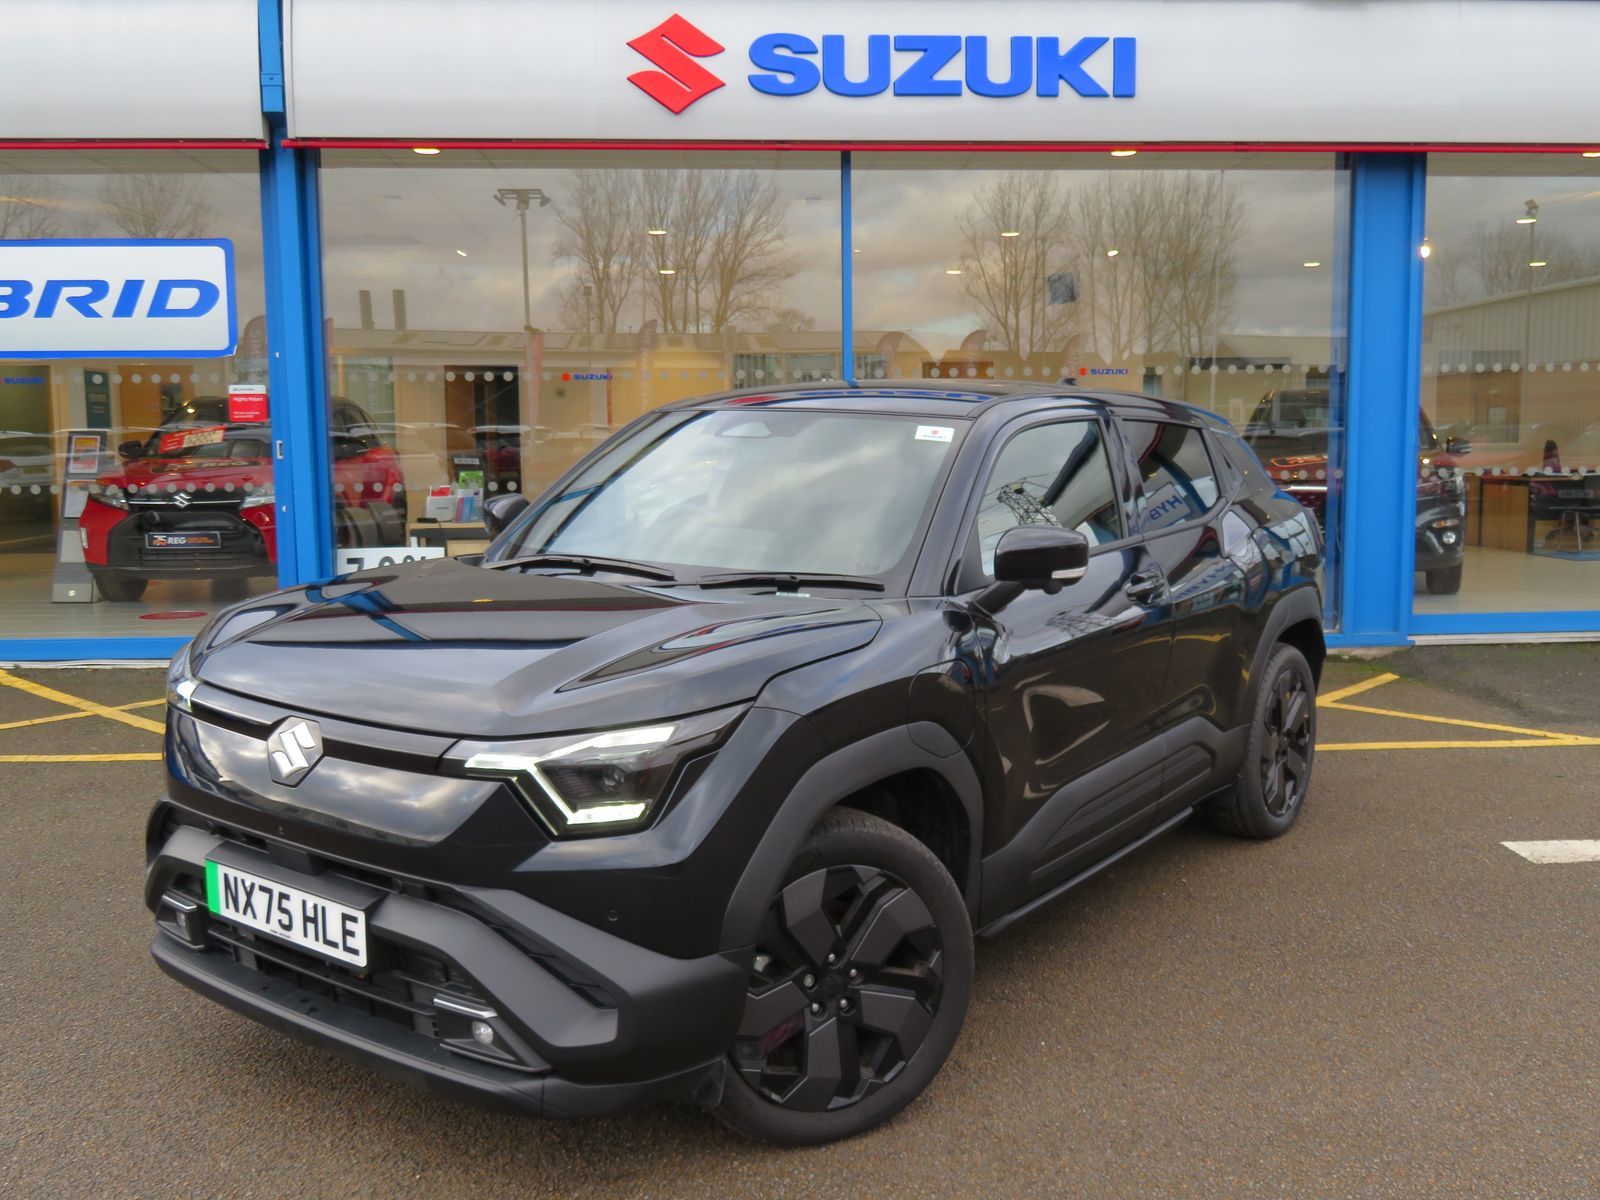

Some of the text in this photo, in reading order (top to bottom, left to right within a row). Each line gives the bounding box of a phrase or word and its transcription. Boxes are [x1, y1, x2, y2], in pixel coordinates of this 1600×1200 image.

[747, 33, 1137, 98] SUZUKI
[0, 279, 220, 319] BRID
[573, 373, 613, 381] SUZUKI
[1090, 368, 1128, 376] SUZUKI
[167, 536, 186, 545] REG
[223, 872, 361, 957] NX75 HLE
